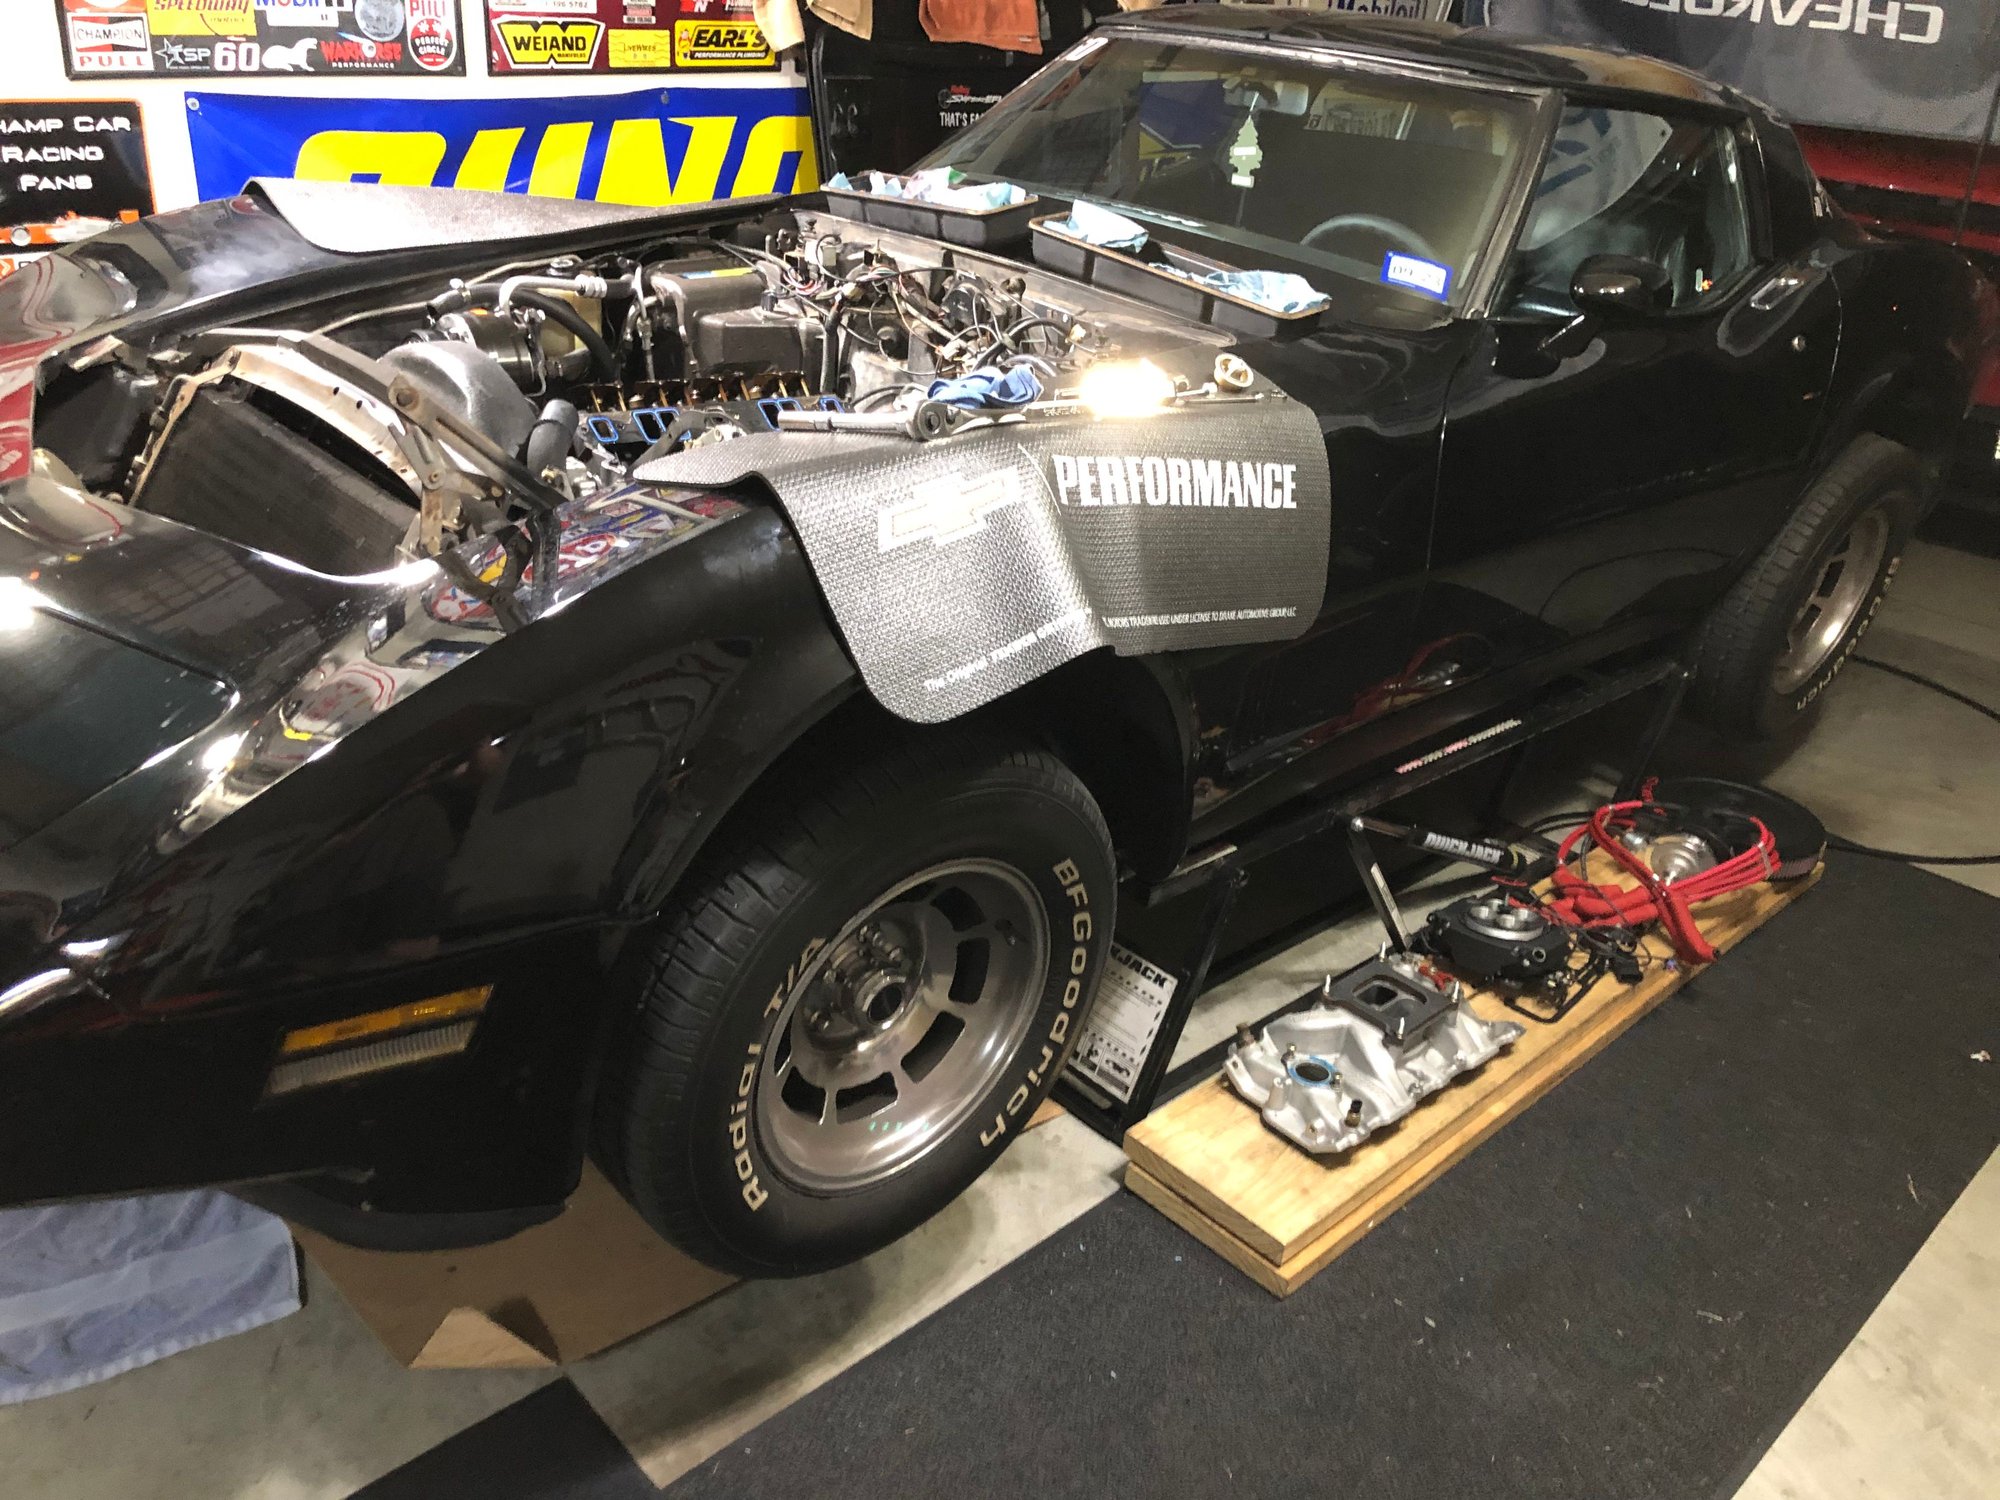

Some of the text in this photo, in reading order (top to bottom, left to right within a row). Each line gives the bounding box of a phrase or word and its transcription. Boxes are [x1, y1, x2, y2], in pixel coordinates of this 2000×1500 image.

[76, 28, 143, 41] CHAMPION
[693, 29, 767, 48] EARL'S
[513, 36, 587, 51] WEIAND
[79, 55, 146, 67] PULL
[213, 42, 260, 71] 60
[332, 61, 395, 69] PERFORMANCE
[73, 116, 131, 133] CAR
[940, 112, 968, 127] THAT'S
[2, 146, 105, 163] RACING
[19, 174, 93, 192] FANS
[1052, 454, 1297, 509] PERFORMANCE
[978, 858, 1092, 1148] BFGoodrich
